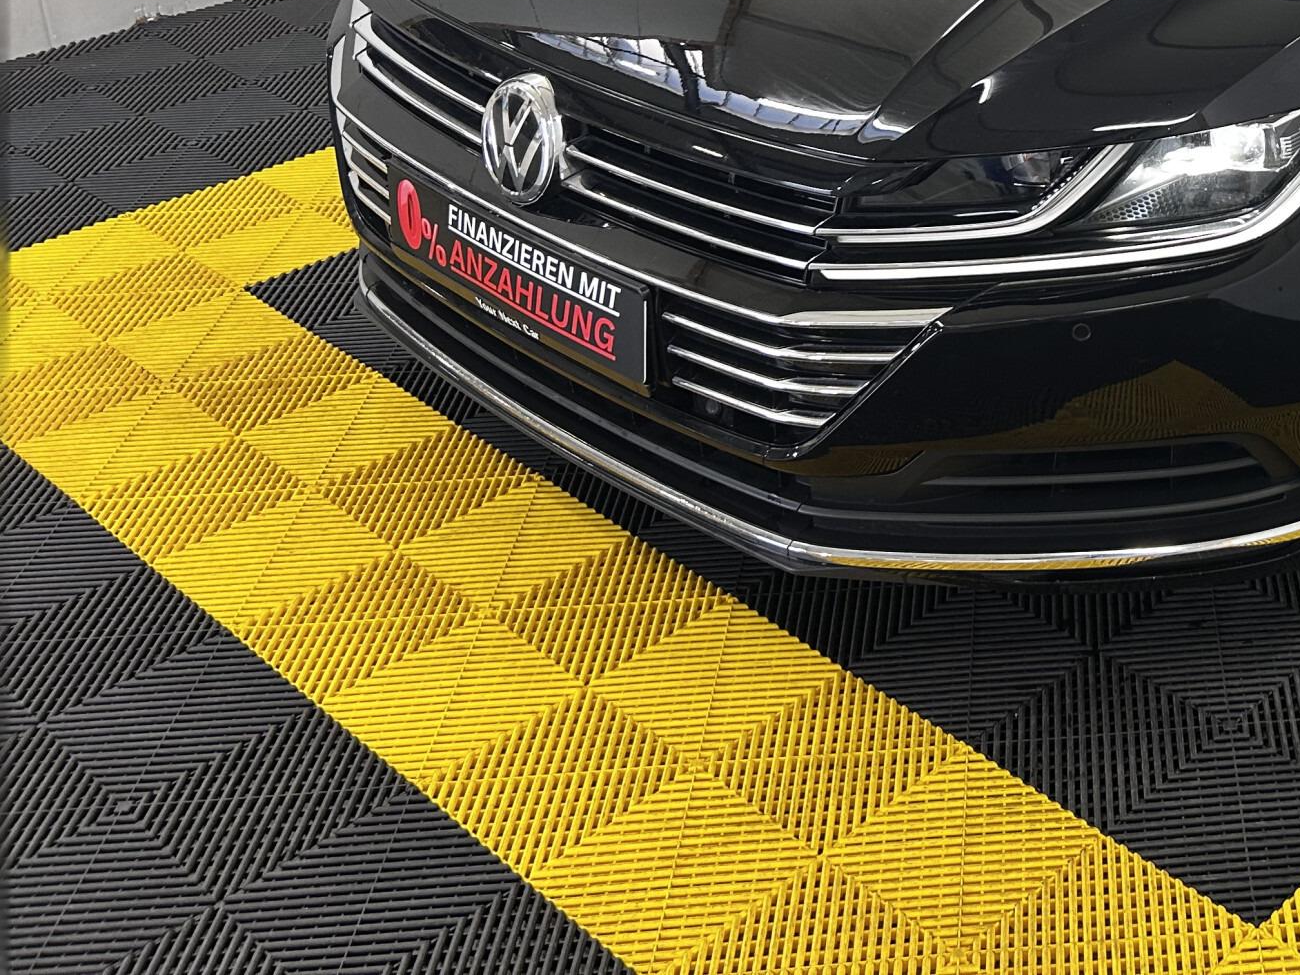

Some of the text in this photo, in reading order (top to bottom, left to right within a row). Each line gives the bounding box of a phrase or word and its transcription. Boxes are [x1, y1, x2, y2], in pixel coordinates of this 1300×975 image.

[396, 178, 617, 354] 0% ANZAHLUNG
[448, 203, 622, 310] FINANZIEREN MIT
[474, 296, 498, 318] Your
[522, 323, 540, 340] Car
